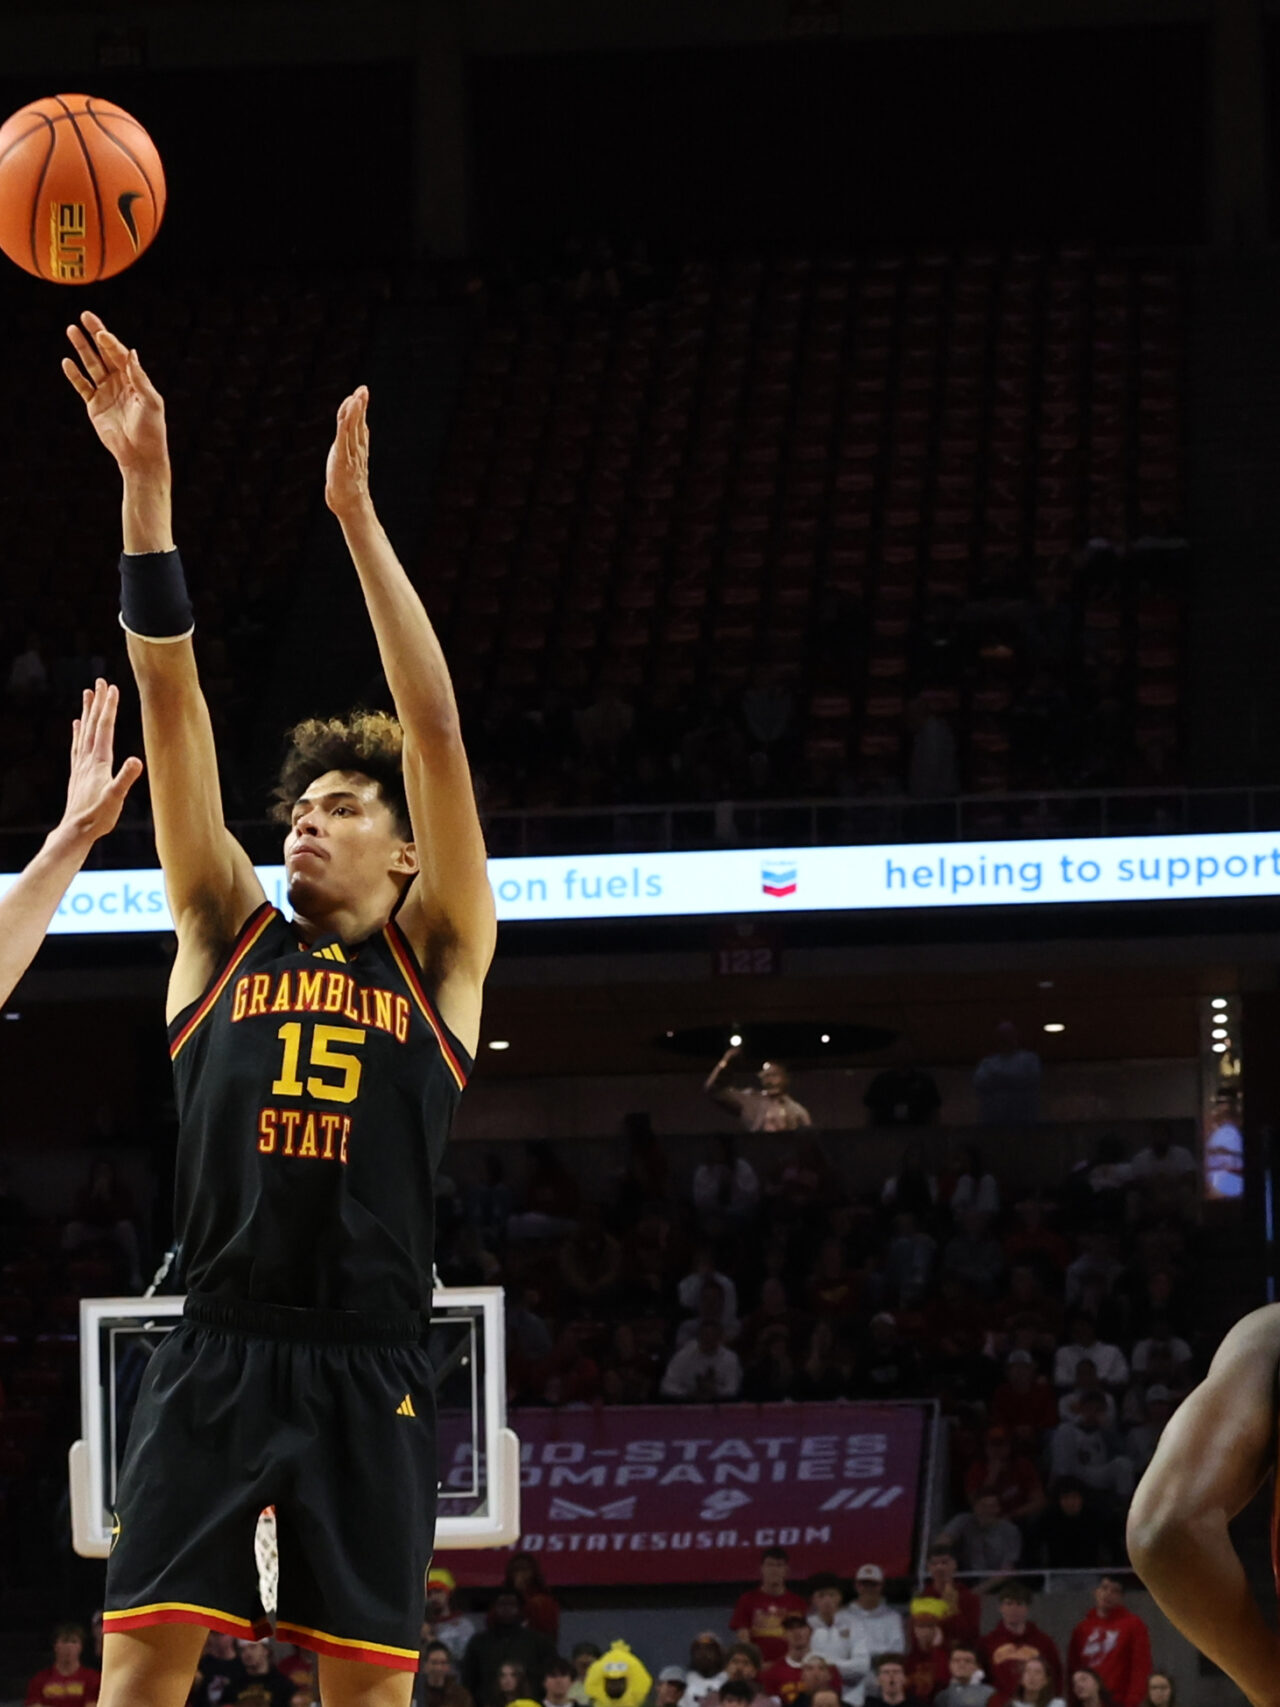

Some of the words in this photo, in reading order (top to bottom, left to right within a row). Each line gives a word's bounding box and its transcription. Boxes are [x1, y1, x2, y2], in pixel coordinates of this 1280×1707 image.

[57, 202, 86, 279] ELITE
[564, 867, 662, 900] fuels
[886, 856, 1042, 894] helping
[1060, 855, 1101, 883] to
[1118, 848, 1280, 887] support
[230, 969, 412, 1044] GRAMBLING
[272, 1022, 366, 1104] 15
[257, 1107, 352, 1164] STATE
[495, 1525, 832, 1552] DSTATESUSA.COM
